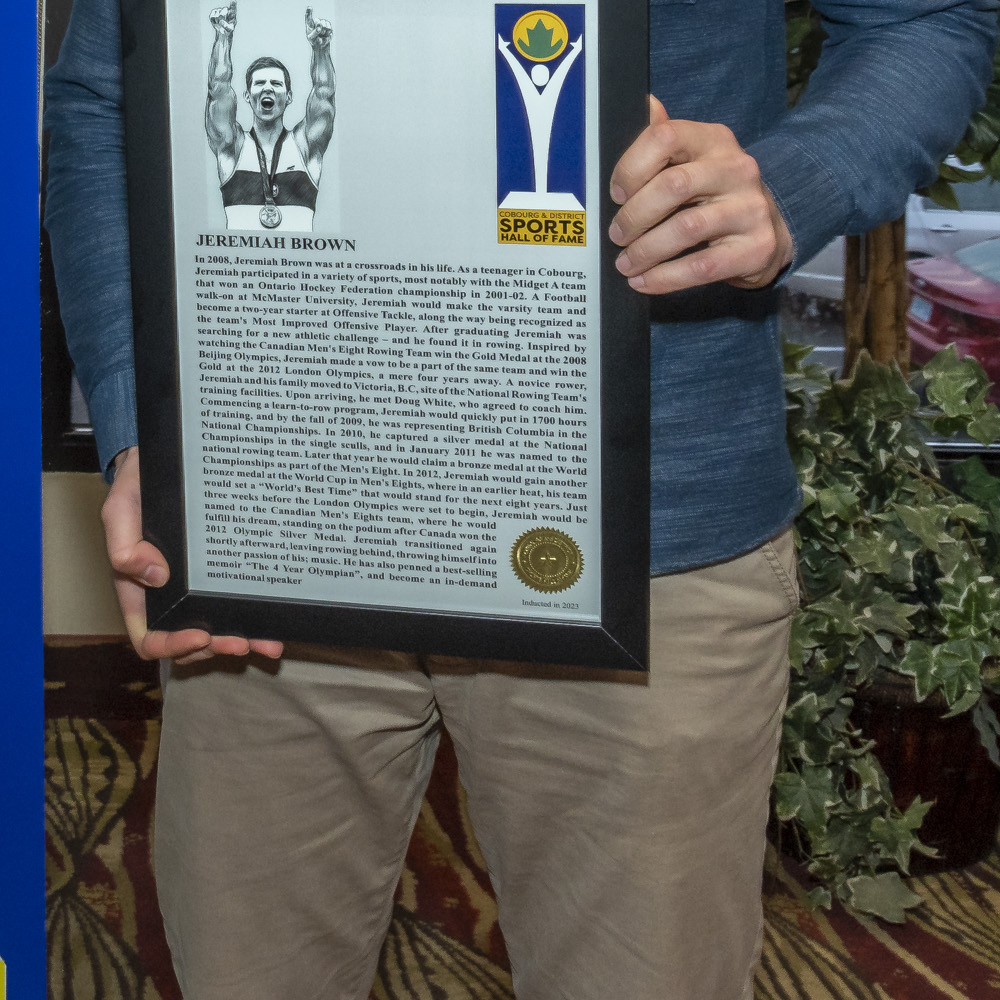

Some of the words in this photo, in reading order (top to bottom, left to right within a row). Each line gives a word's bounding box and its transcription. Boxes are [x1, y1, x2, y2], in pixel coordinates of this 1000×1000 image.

[499, 211, 540, 219] COBOURG
[500, 218, 585, 235] SPORTS
[196, 234, 286, 249] JEREMIAH
[291, 237, 357, 251] BROWN
[501, 233, 530, 242] HALL
[533, 234, 548, 242] OF
[552, 235, 584, 244] FAME
[195, 254, 205, 263] In
[207, 255, 232, 265] 2008,
[234, 256, 278, 265] Jeremiah
[281, 258, 312, 267] Brown
[355, 261, 406, 271] crossroads
[408, 263, 417, 271] in
[421, 263, 434, 272] his
[437, 264, 455, 272] life.
[457, 264, 469, 273] As
[480, 266, 523, 277] teenager
[526, 267, 535, 275] in
[538, 267, 586, 279] Cobourg,
[196, 278, 214, 287] that
[258, 281, 296, 290] Ontario
[300, 283, 336, 294] Hockey
[341, 284, 393, 294] Federation
[398, 287, 466, 299] championship
[471, 289, 480, 298] in
[485, 290, 527, 300] 2001-02.
[545, 292, 586, 302] Football
[196, 290, 233, 300] walk-on
[252, 293, 301, 302] McMaster
[306, 295, 357, 307] University,
[362, 297, 406, 307] Jeremiah
[411, 299, 441, 309] would
[446, 301, 473, 310] make
[478, 302, 493, 311] the
[498, 303, 532, 315] varsity
[538, 306, 562, 314] team
[567, 306, 586, 315] and
[197, 314, 211, 322] the
[217, 315, 247, 324] team's
[252, 316, 276, 325] Most
[282, 318, 328, 330] Improved
[333, 320, 379, 330] Offensive
[385, 323, 417, 334] Player.
[423, 324, 449, 333] After
[454, 326, 509, 338] graduating
[515, 329, 561, 339] Jeremiah
[198, 338, 240, 350] watching
[242, 340, 257, 349] the
[259, 341, 305, 351] Canadian
[307, 343, 336, 352] Men's
[339, 345, 364, 356] Eight
[367, 346, 403, 358] Rowing
[405, 348, 432, 357] Team
[434, 349, 452, 358] win
[454, 350, 470, 359] the
[472, 351, 496, 360] Gold
[499, 352, 530, 362] Medal
[545, 354, 560, 363] the
[563, 355, 586, 364] 2008
[200, 385, 237, 397] training
[241, 387, 282, 397] facilities.
[286, 390, 311, 401] Upon
[314, 391, 356, 403] arriving,
[359, 394, 370, 402] he
[374, 395, 391, 403] met
[395, 396, 420, 407] Doug
[423, 397, 456, 408] White,
[459, 399, 479, 408] who
[483, 401, 516, 412] agreed
[532, 403, 561, 413] coach
[565, 405, 586, 414] him.
[200, 397, 262, 410] Commencing
[272, 401, 331, 412] learn-to-row
[334, 407, 378, 417] program,
[381, 407, 425, 417] Jeremiah
[429, 410, 458, 419] would
[461, 411, 497, 423] quickly
[500, 414, 517, 424] put
[520, 415, 529, 423] in
[533, 415, 555, 424] 1700
[559, 417, 587, 426] hours
[201, 420, 241, 430] National
[245, 423, 321, 437] Championships.
[326, 428, 335, 436] In
[340, 428, 365, 439] 2010,
[370, 430, 381, 439] he
[385, 431, 428, 443] captured
[443, 434, 470, 444] silver
[475, 436, 504, 446] medal
[509, 439, 519, 447] at
[524, 439, 539, 448] the
[544, 440, 587, 451] National
[203, 455, 275, 469] Championships
[289, 462, 309, 471] part
[311, 462, 321, 470] of
[323, 463, 338, 471] the
[341, 464, 369, 473] Men's
[372, 466, 400, 477] Eight.
[403, 468, 413, 476] In
[416, 469, 441, 479] 2012,
[444, 470, 489, 481] Jeremiah
[492, 474, 521, 483] would
[524, 476, 545, 487] gain
[548, 477, 587, 488] another
[204, 489, 227, 499] three
[231, 491, 258, 501] weeks
[262, 493, 291, 503] before
[295, 496, 309, 504] the
[314, 497, 349, 507] London
[353, 500, 398, 513] Olympics
[429, 506, 441, 514] set
[459, 507, 488, 519] begin,
[492, 509, 537, 520] Jeremiah
[542, 513, 571, 522] would
[576, 515, 587, 523] be
[206, 524, 226, 533] 2012
[234, 526, 273, 538] Olympic
[280, 529, 307, 539] Silver
[314, 532, 346, 542] Medal.
[353, 535, 397, 546] Jeremiah
[405, 539, 462, 551] transitioned
[471, 544, 496, 555] again
[207, 570, 265, 582] motivational
[266, 574, 302, 586] speaker
[522, 599, 552, 608] Inducted
